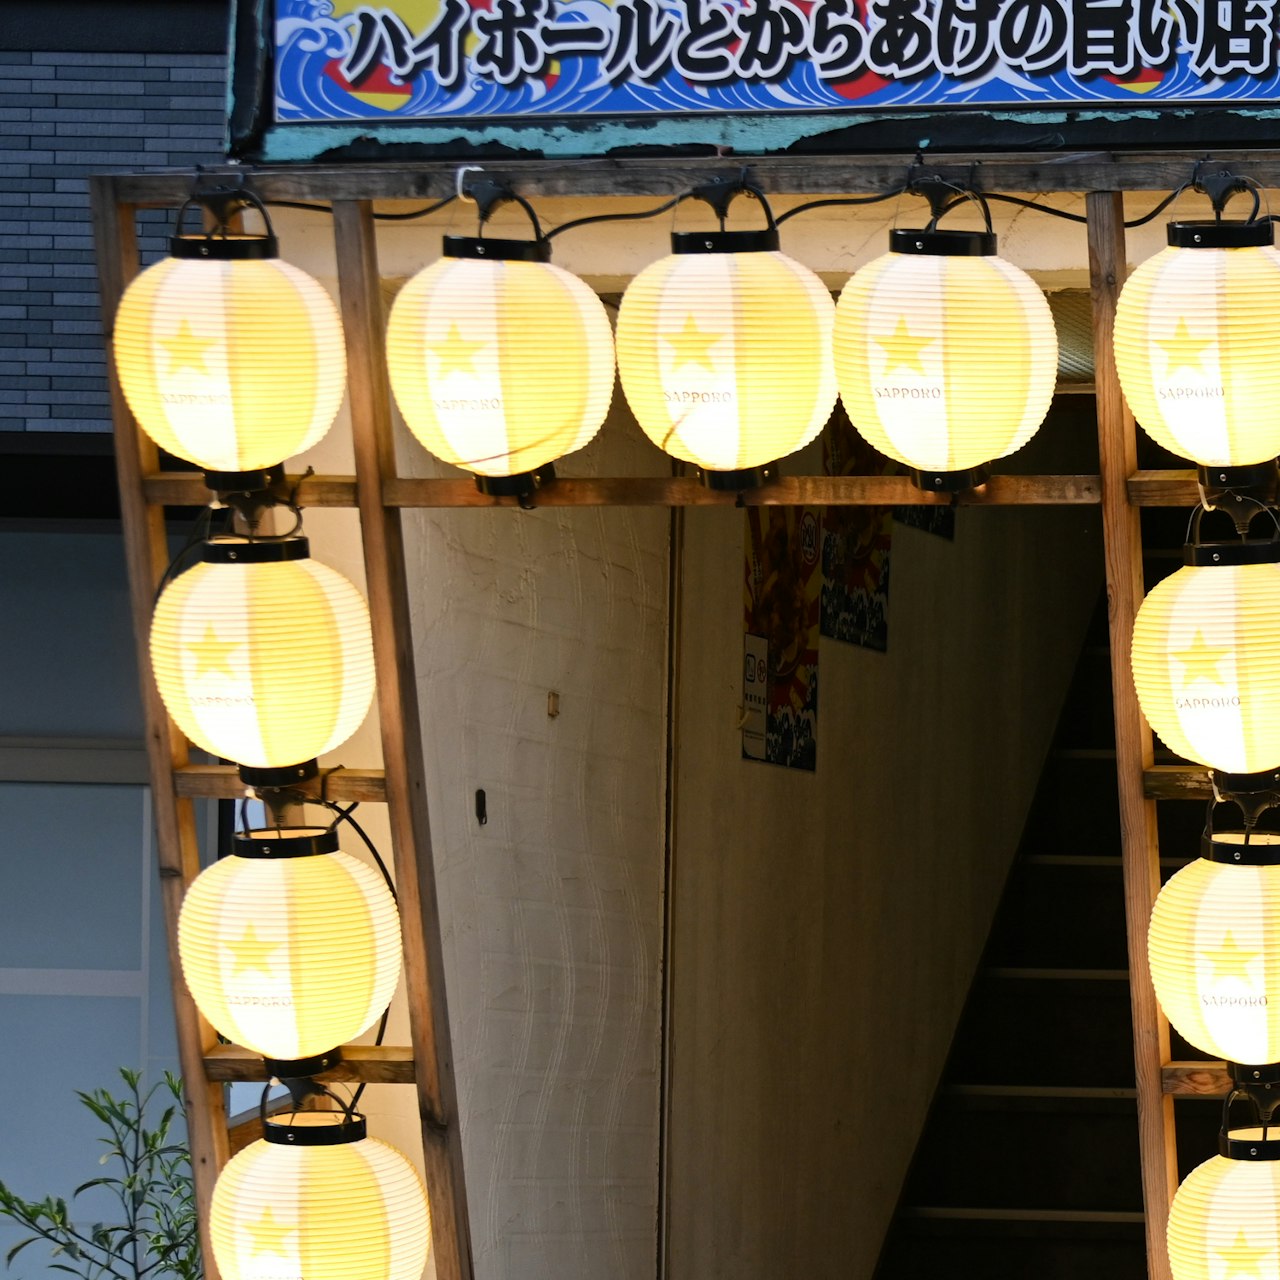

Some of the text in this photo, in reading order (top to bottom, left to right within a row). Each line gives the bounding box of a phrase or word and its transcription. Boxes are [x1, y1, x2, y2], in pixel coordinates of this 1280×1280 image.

[664, 392, 732, 403] SAPPORO
[874, 387, 941, 399] SAPPORO
[1159, 387, 1225, 400] SAPPORO
[1175, 696, 1241, 709] SAPPORO
[1202, 995, 1268, 1008] SAPPORO
